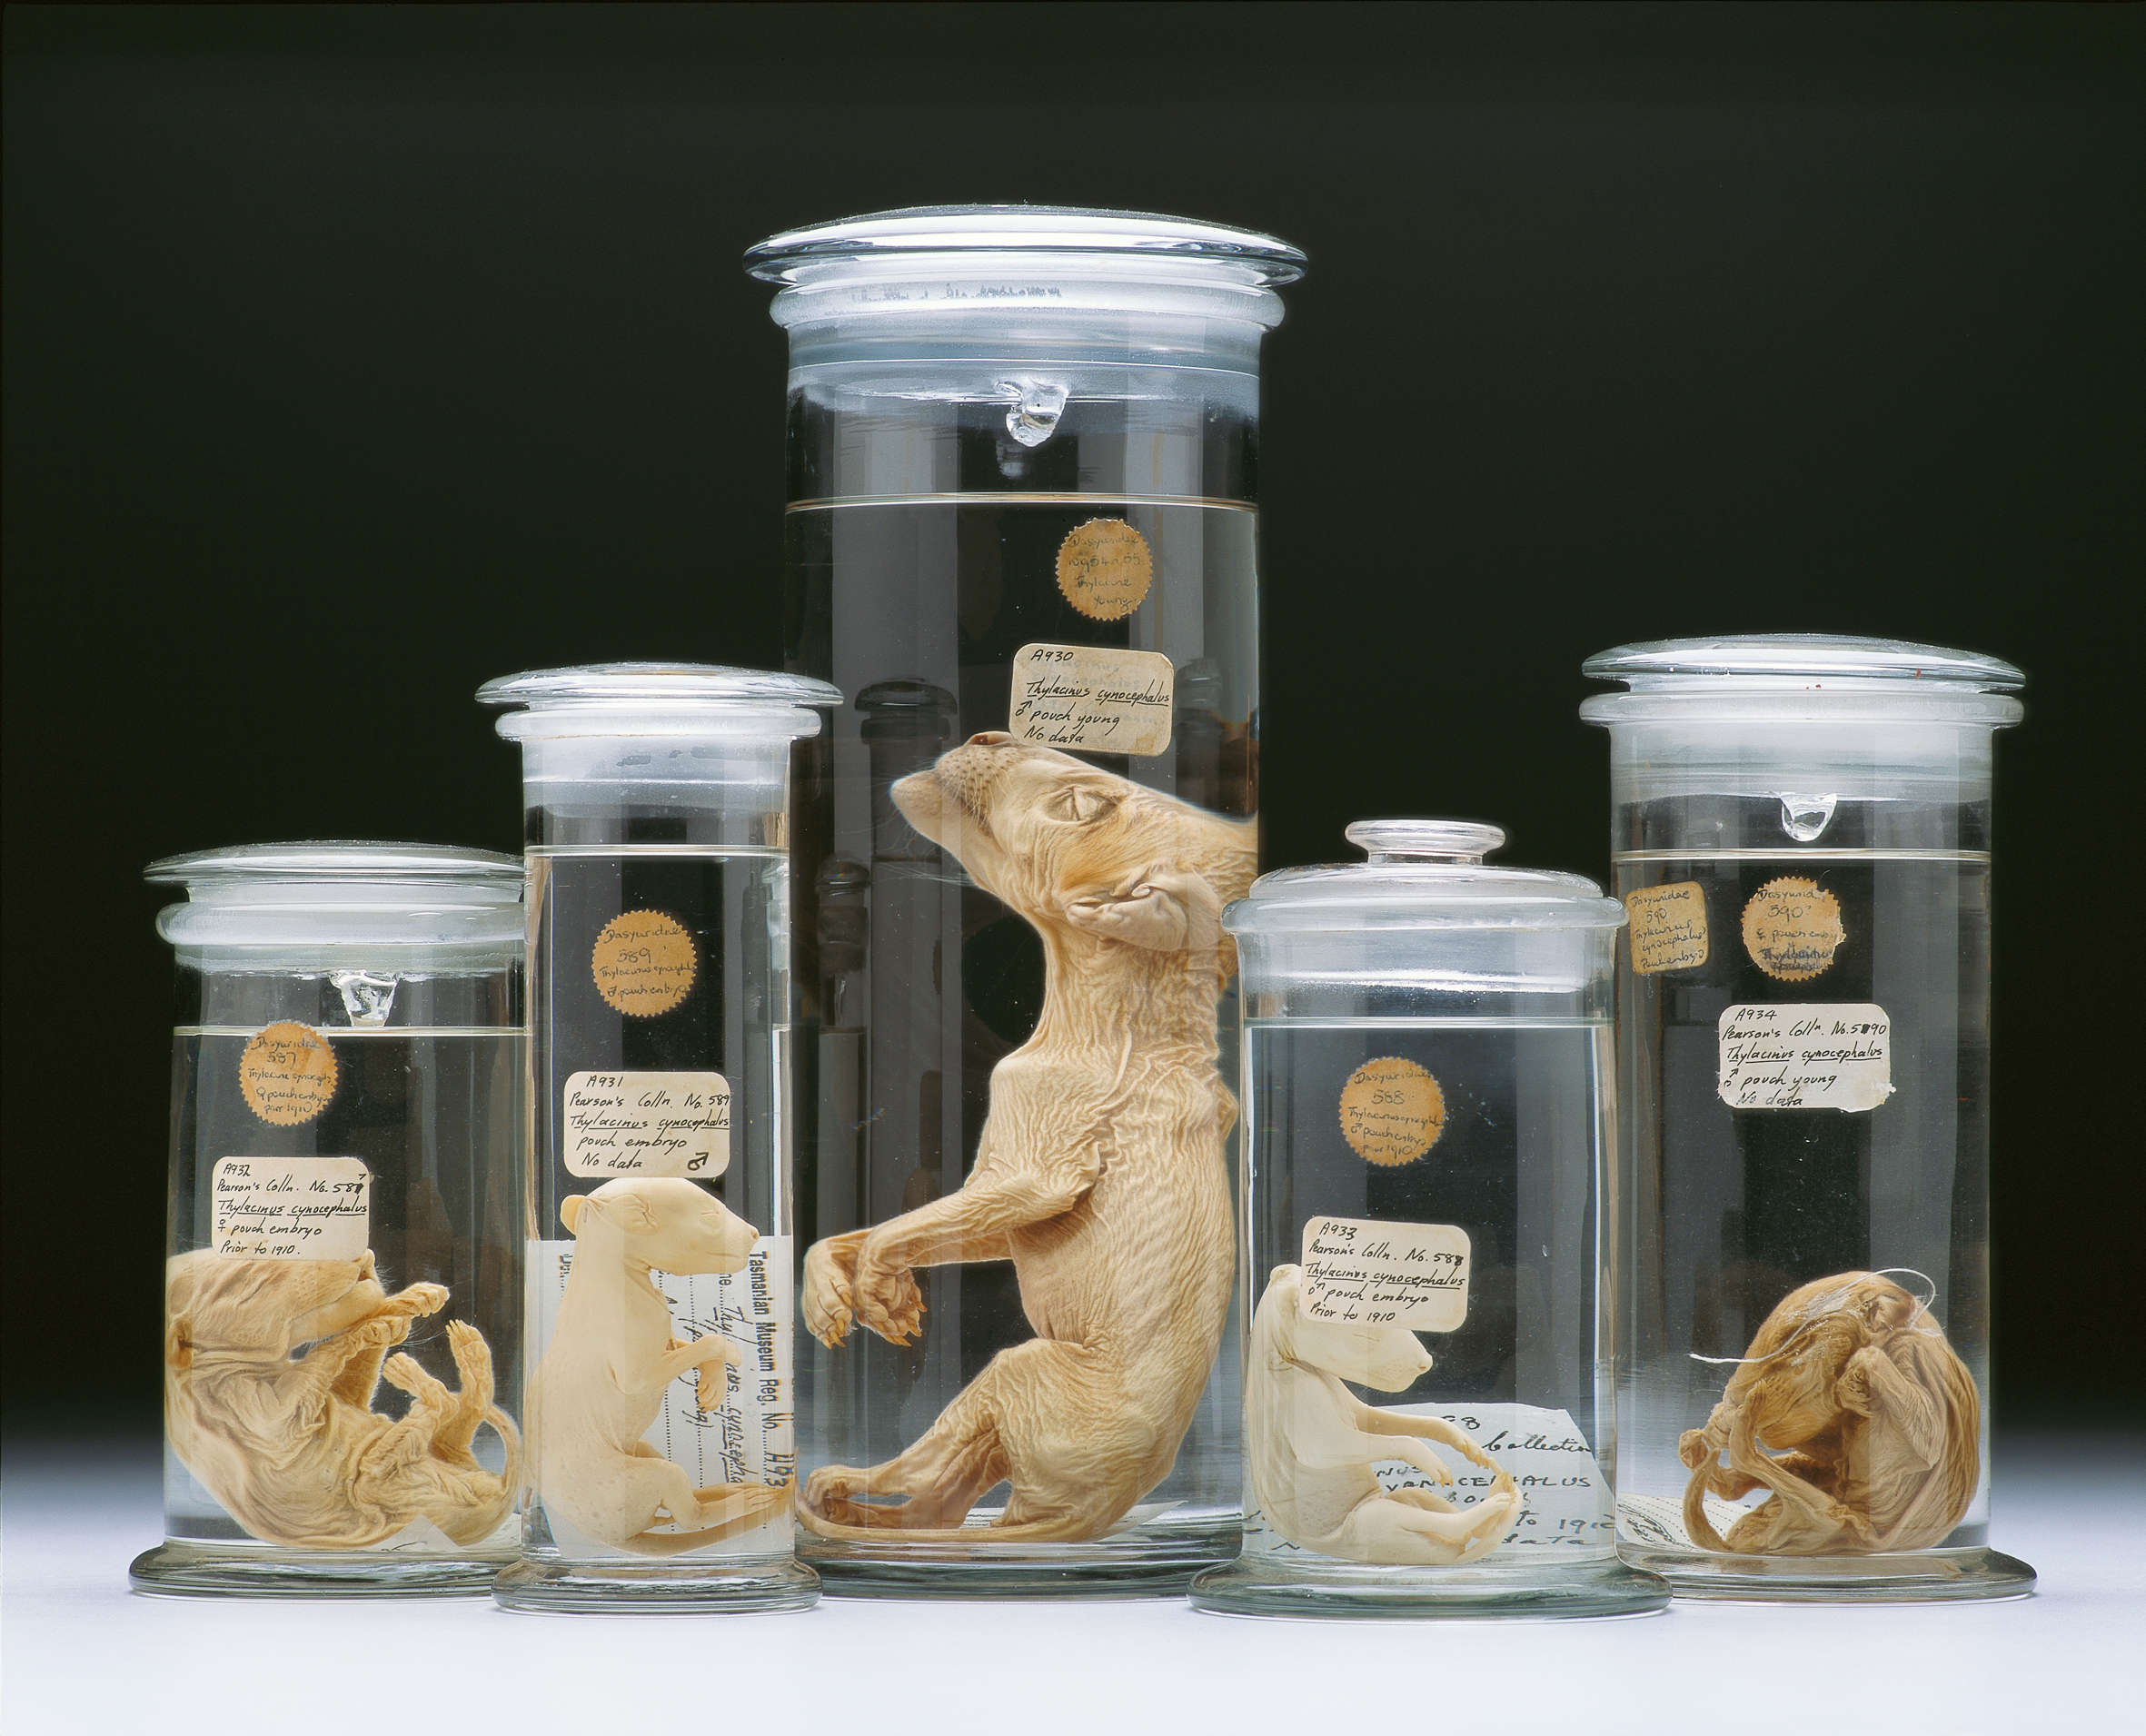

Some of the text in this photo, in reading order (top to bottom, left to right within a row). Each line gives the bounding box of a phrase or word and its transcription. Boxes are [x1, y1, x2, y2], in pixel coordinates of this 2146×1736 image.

[1030, 650, 1074, 661] A930
[1027, 675, 1090, 700] Thylacinus
[1095, 679, 1169, 707] cynocephalus
[1029, 702, 1076, 722] pouch
[1073, 715, 1119, 736] young
[1024, 725, 1085, 743] No data
[1735, 1008, 1777, 1021] A934
[1722, 1025, 1781, 1041] Pearson's
[1727, 1041, 1883, 1066] Thylacinus cynocephalus
[586, 1076, 623, 1087] A931
[1740, 1066, 1837, 1092] pouch young
[570, 1091, 730, 1109] Pearson's Colln. No. 589
[1372, 1090, 1405, 1105] 588
[1736, 1086, 1803, 1106] No data
[571, 1108, 729, 1133] Thylacinus cynocephalus
[577, 1130, 687, 1156] pouch embryo
[223, 1163, 251, 1176] A932
[581, 1149, 642, 1169] No data
[217, 1179, 260, 1192] Pearson's
[266, 1174, 299, 1192] Colln.
[309, 1180, 328, 1193] No.
[218, 1195, 367, 1219] Thylacinus cynocephalus
[231, 1217, 322, 1239] pouch embryo
[1319, 1222, 1357, 1240] A933
[220, 1240, 247, 1254] Prior
[254, 1243, 266, 1254] to
[1308, 1239, 1355, 1255] Pearson's
[1362, 1242, 1396, 1260] Colln.
[1405, 1248, 1427, 1262] No.
[749, 1252, 770, 1315] Tasmanian
[1306, 1261, 1465, 1288] Thylacinus cynocephalus
[1324, 1283, 1429, 1310] pouch embryo
[1310, 1302, 1396, 1323] Prior to 1910
[755, 1323, 777, 1372] Museum
[756, 1379, 780, 1406] Reg.
